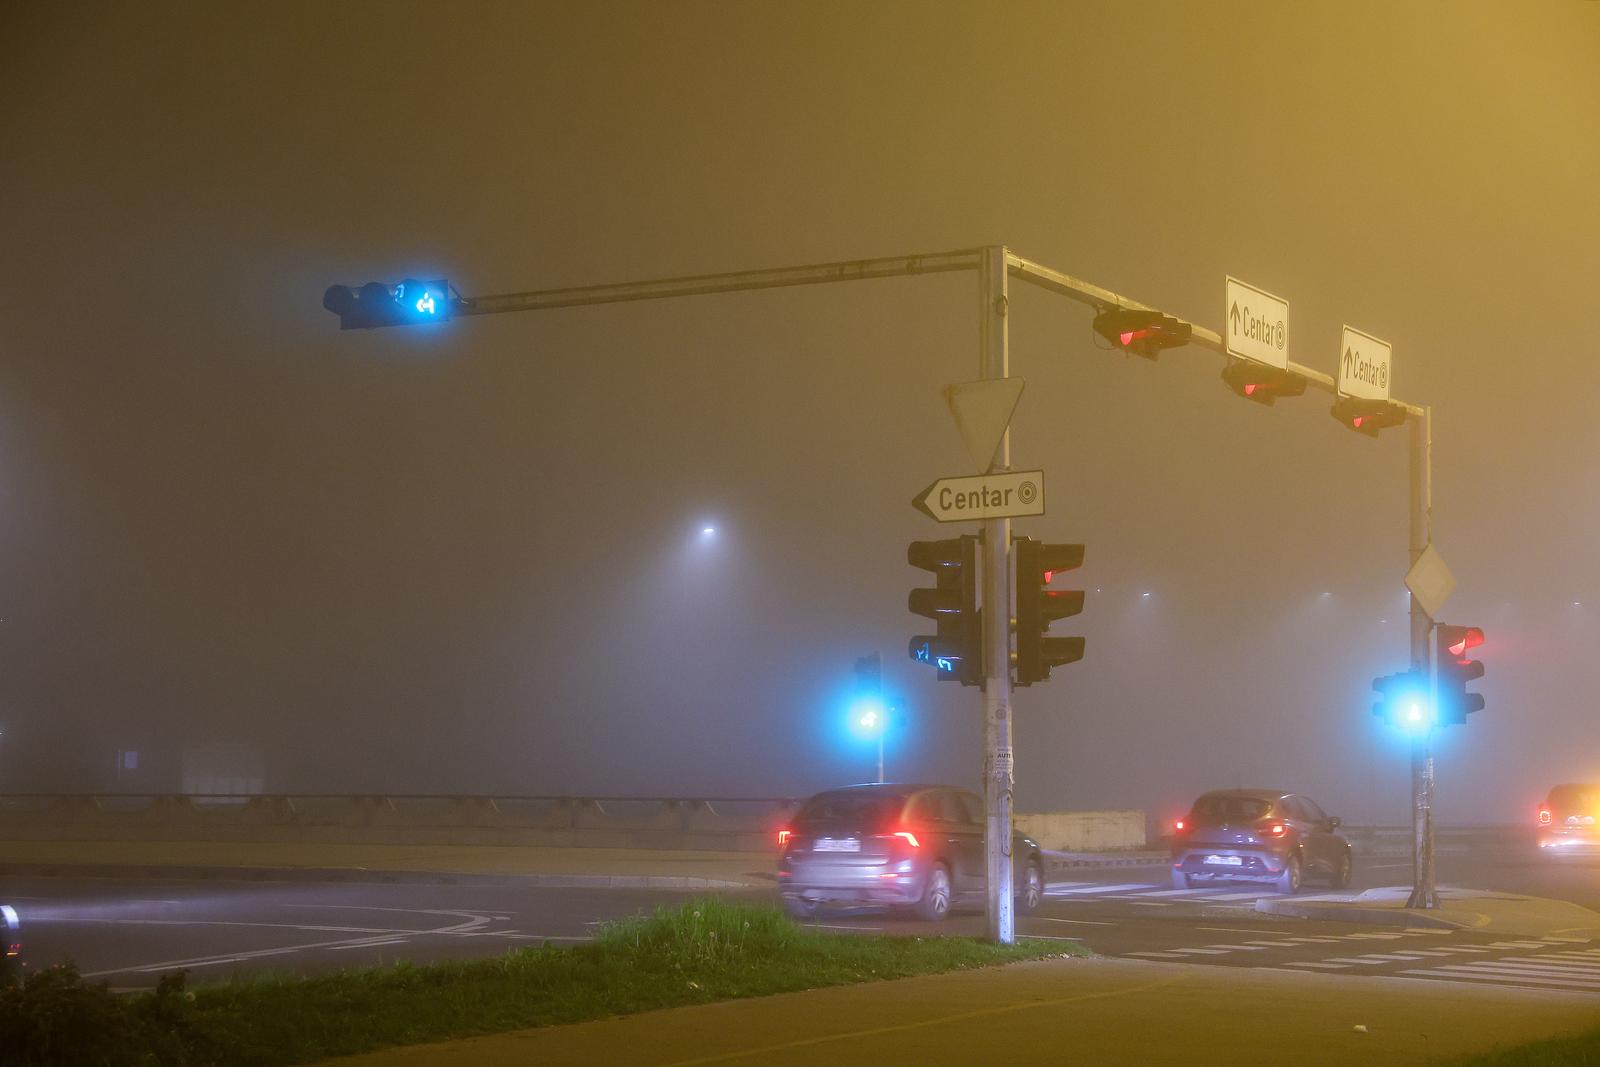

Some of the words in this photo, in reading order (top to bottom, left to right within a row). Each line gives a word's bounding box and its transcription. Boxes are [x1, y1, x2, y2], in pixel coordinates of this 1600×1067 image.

[1243, 306, 1275, 347] Centar
[1353, 351, 1380, 387] Centar
[940, 485, 1013, 511] Centar
